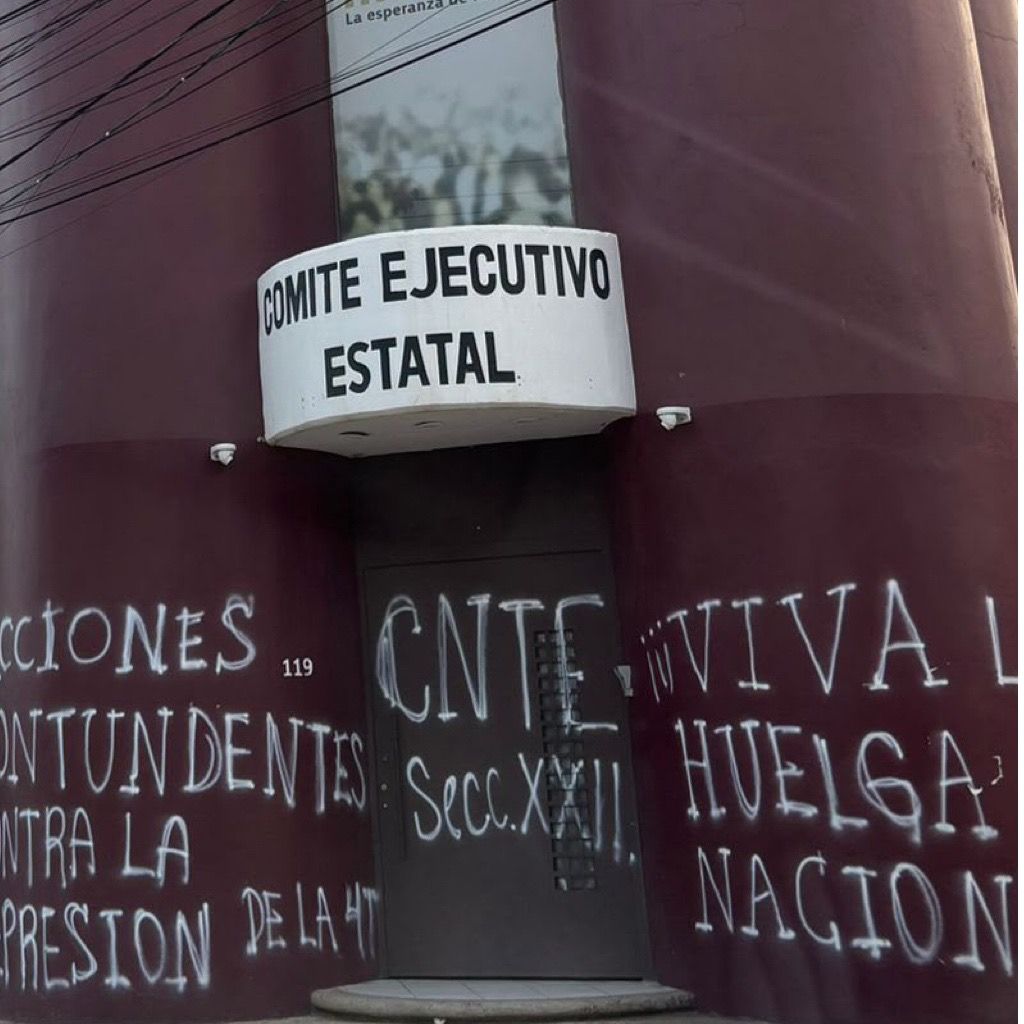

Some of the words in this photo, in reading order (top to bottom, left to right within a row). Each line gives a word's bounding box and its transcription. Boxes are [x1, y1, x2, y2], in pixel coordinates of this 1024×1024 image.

[345, 12, 362, 25] La
[263, 257, 362, 336] COMITE
[380, 242, 612, 302] EJECUTIVO
[324, 331, 516, 398] ESTATAL
[282, 658, 313, 677] 119
[376, 593, 619, 734] CNTE
[675, 718, 998, 845] HUELGA
[122, 812, 190, 888] LA
[0, 898, 212, 993] PRESION
[243, 887, 286, 960] DE
[297, 881, 339, 954] LA
[695, 847, 1016, 977] NACION
